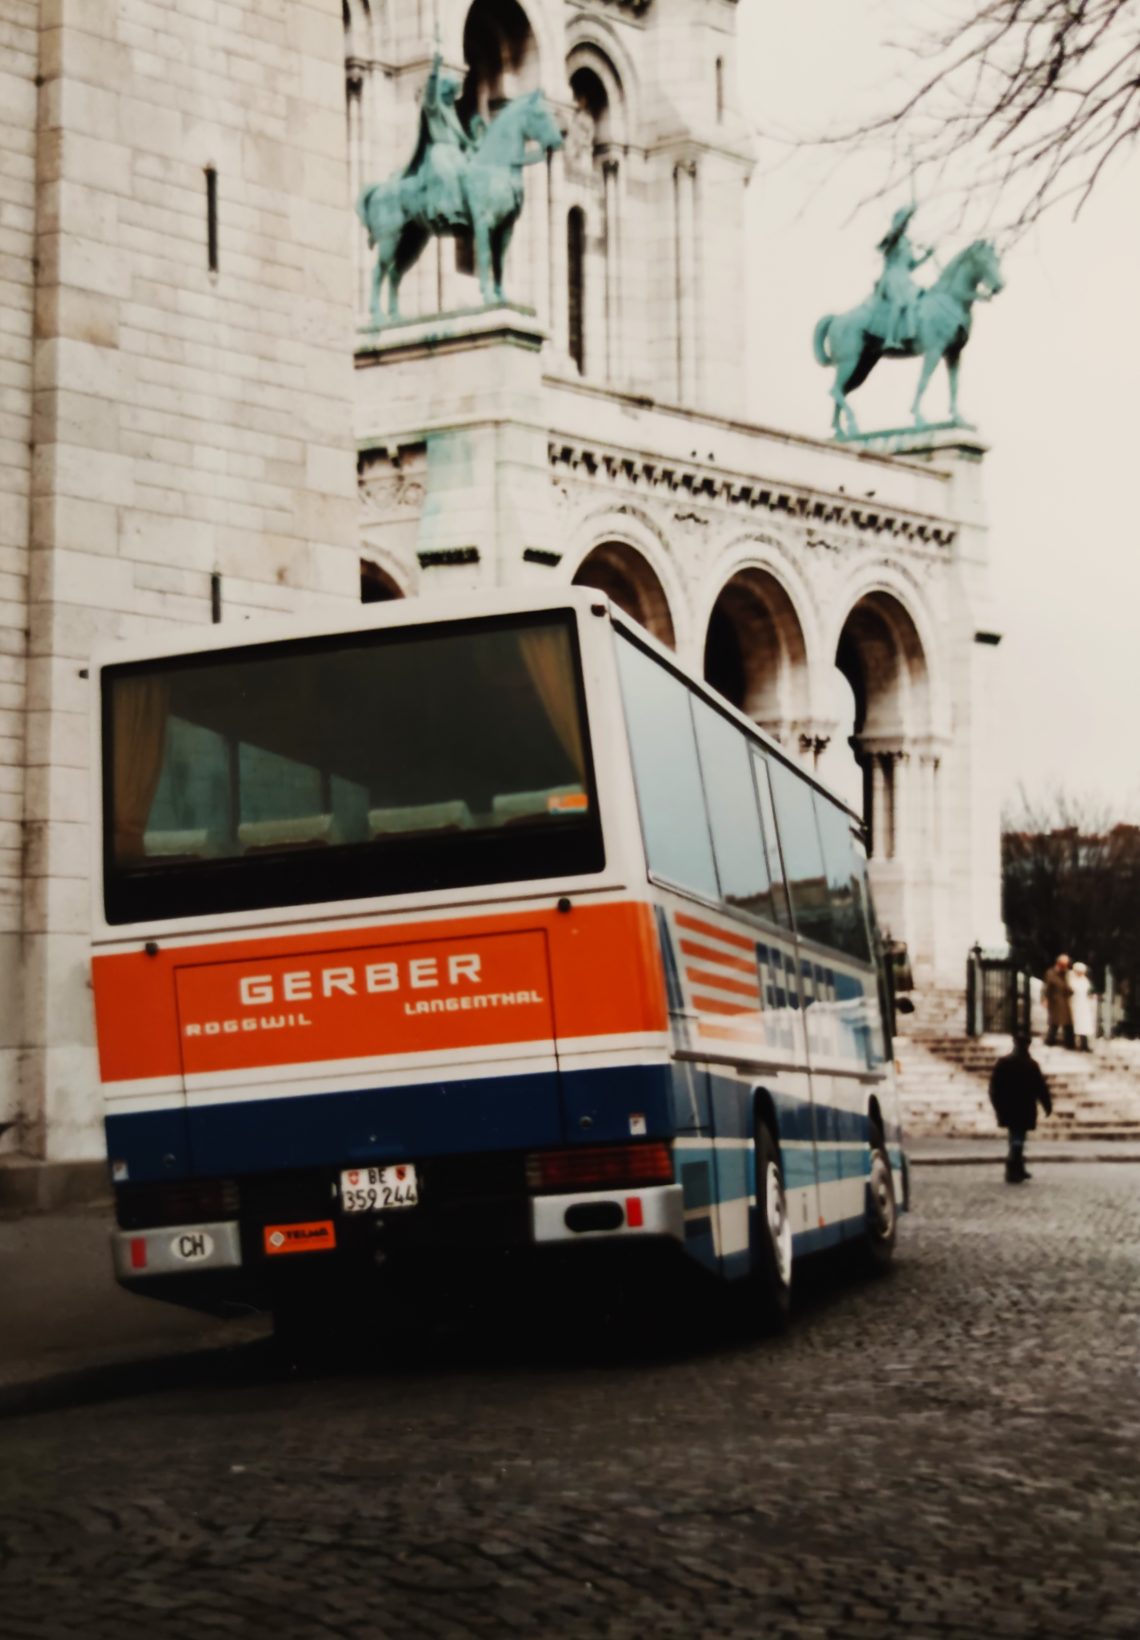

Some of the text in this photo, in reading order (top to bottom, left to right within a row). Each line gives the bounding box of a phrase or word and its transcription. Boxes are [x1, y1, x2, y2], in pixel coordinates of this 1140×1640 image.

[239, 953, 482, 1005] GERBER
[184, 990, 543, 1037] ROGGWIL LANGENTHAL
[368, 1167, 388, 1185] BE
[346, 1185, 416, 1211] 359 244
[178, 1235, 205, 1258] CH
